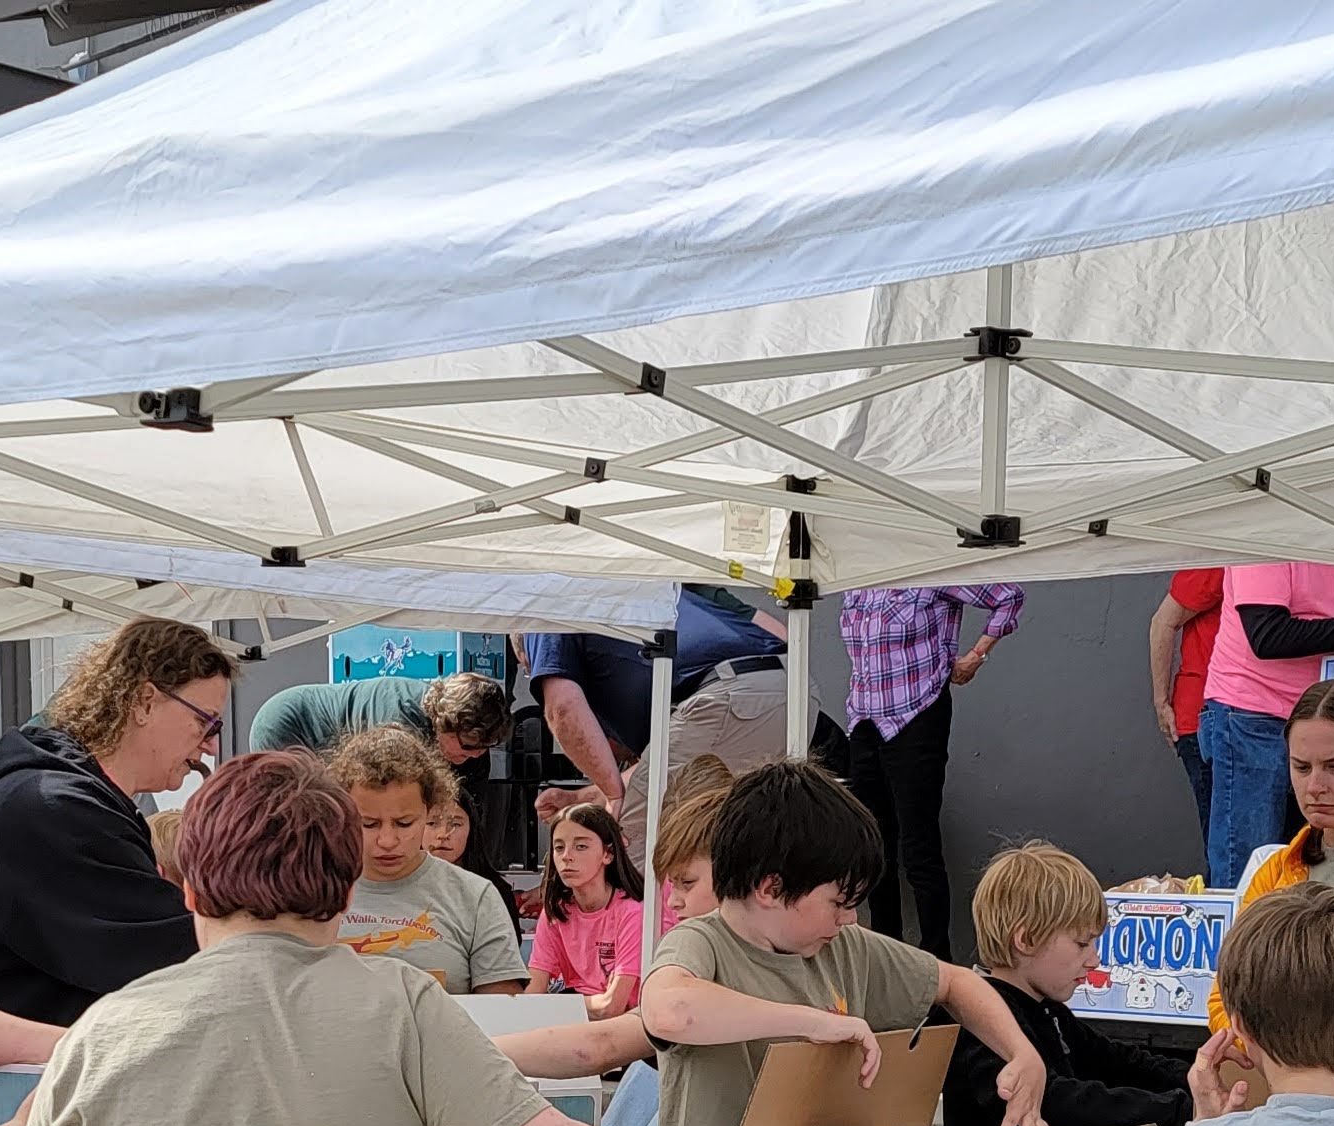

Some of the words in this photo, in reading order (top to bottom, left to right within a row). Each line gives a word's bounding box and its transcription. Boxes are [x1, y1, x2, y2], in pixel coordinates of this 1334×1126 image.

[346, 914, 378, 925] Walla
[380, 916, 445, 942] Torchbearers
[1097, 916, 1223, 972] NORDI
